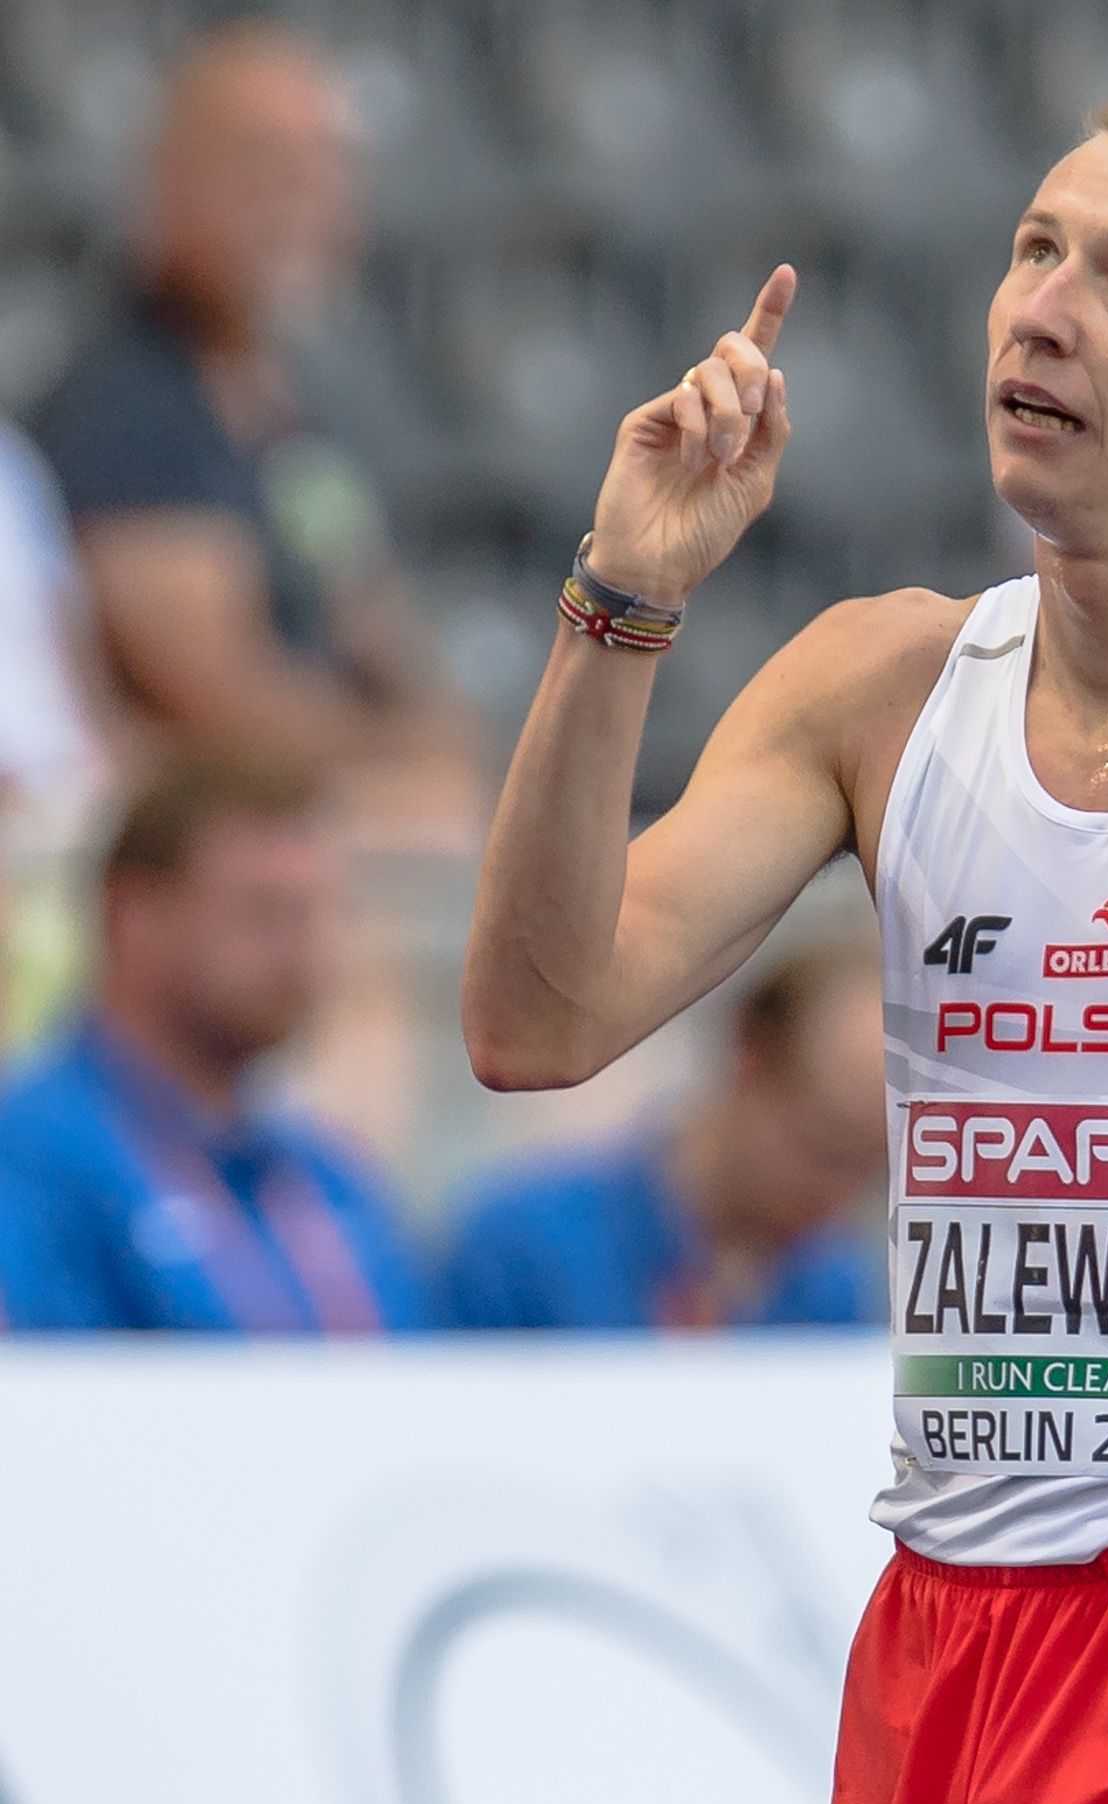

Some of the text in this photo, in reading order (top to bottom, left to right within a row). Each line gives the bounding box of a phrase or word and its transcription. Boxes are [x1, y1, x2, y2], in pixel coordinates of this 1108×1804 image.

[923, 915, 1012, 974] 4F
[958, 1363, 964, 1390] I
[973, 1363, 1033, 1391] RUN
[923, 1409, 1074, 1463] BERLIN
